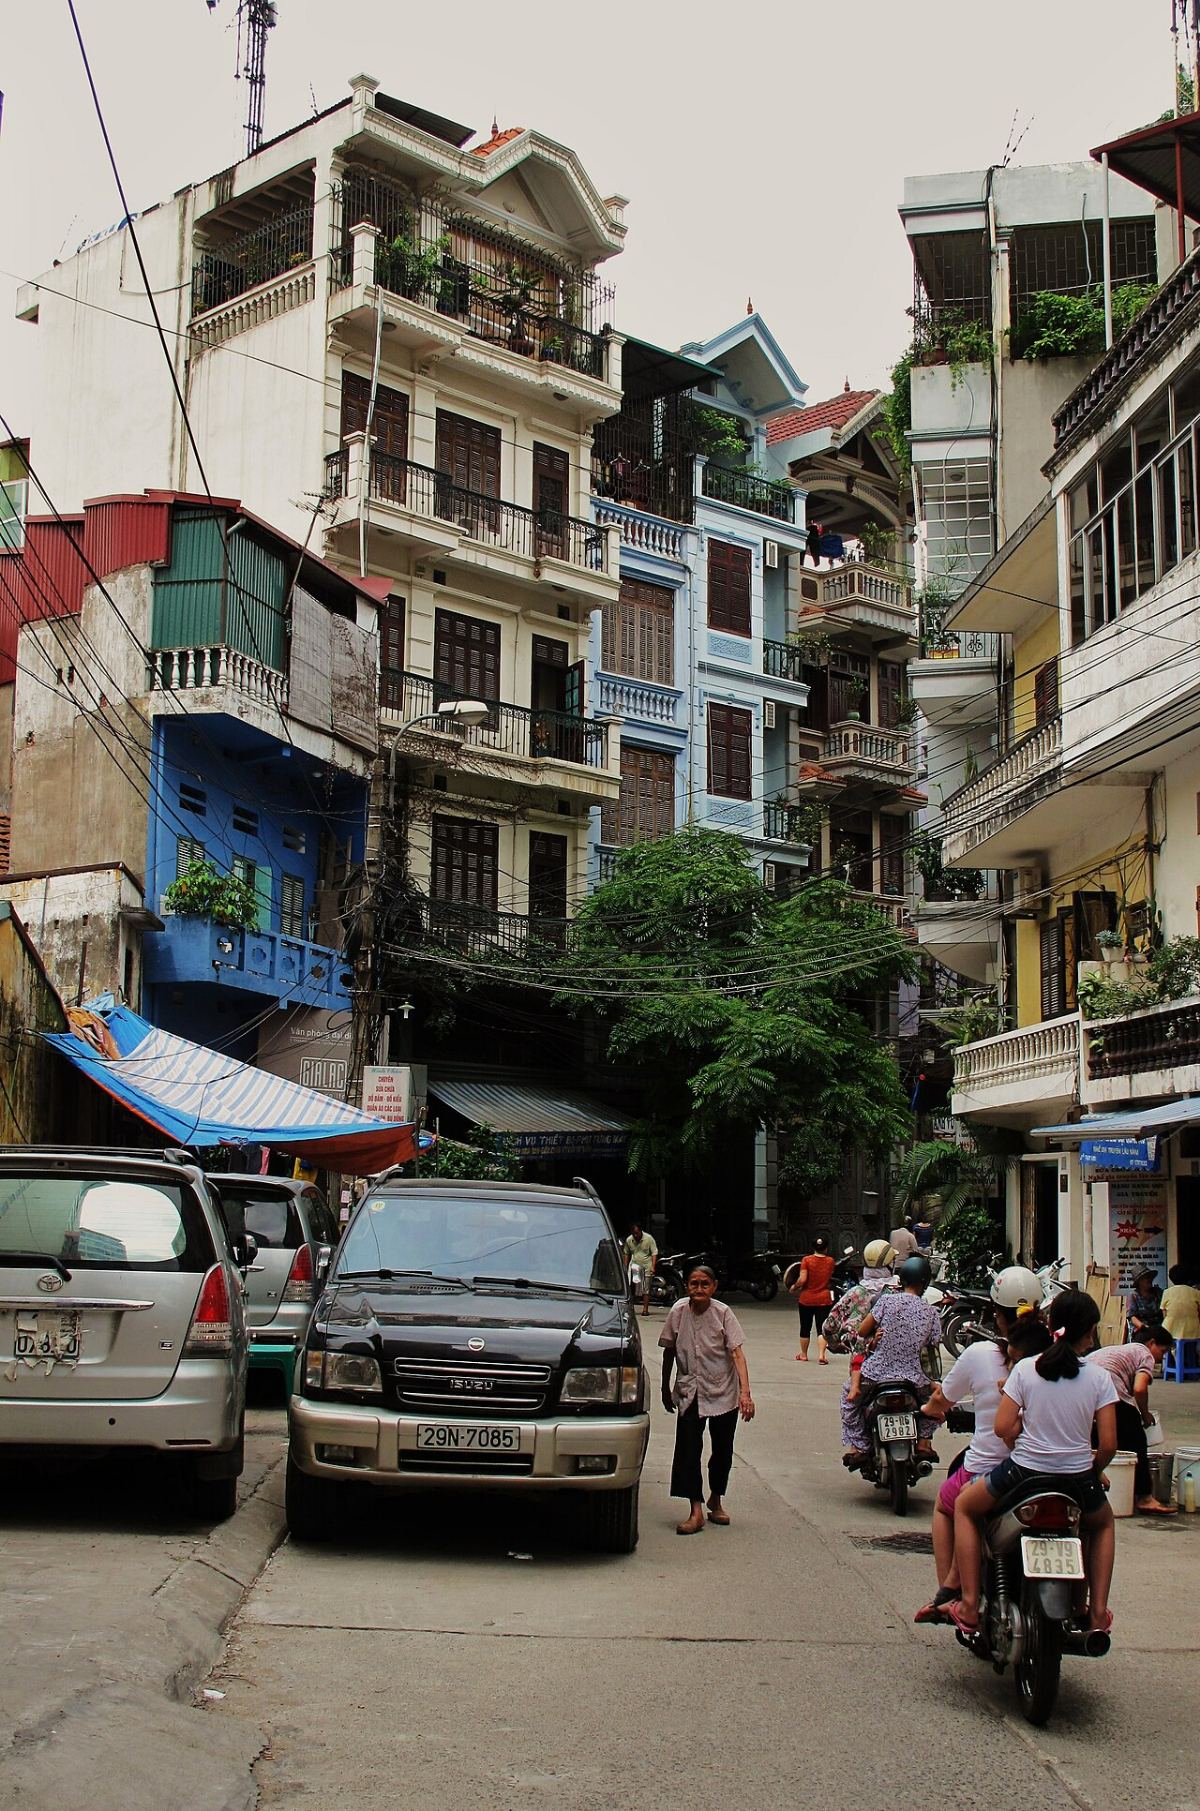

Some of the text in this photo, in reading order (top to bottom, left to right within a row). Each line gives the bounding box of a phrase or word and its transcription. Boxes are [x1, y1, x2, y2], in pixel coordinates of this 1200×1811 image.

[450, 1379, 493, 1390] ISUZU
[424, 1427, 514, 1448] 29N-7085
[885, 1426, 911, 1437] 2982
[1030, 1541, 1073, 1557] 29-V9
